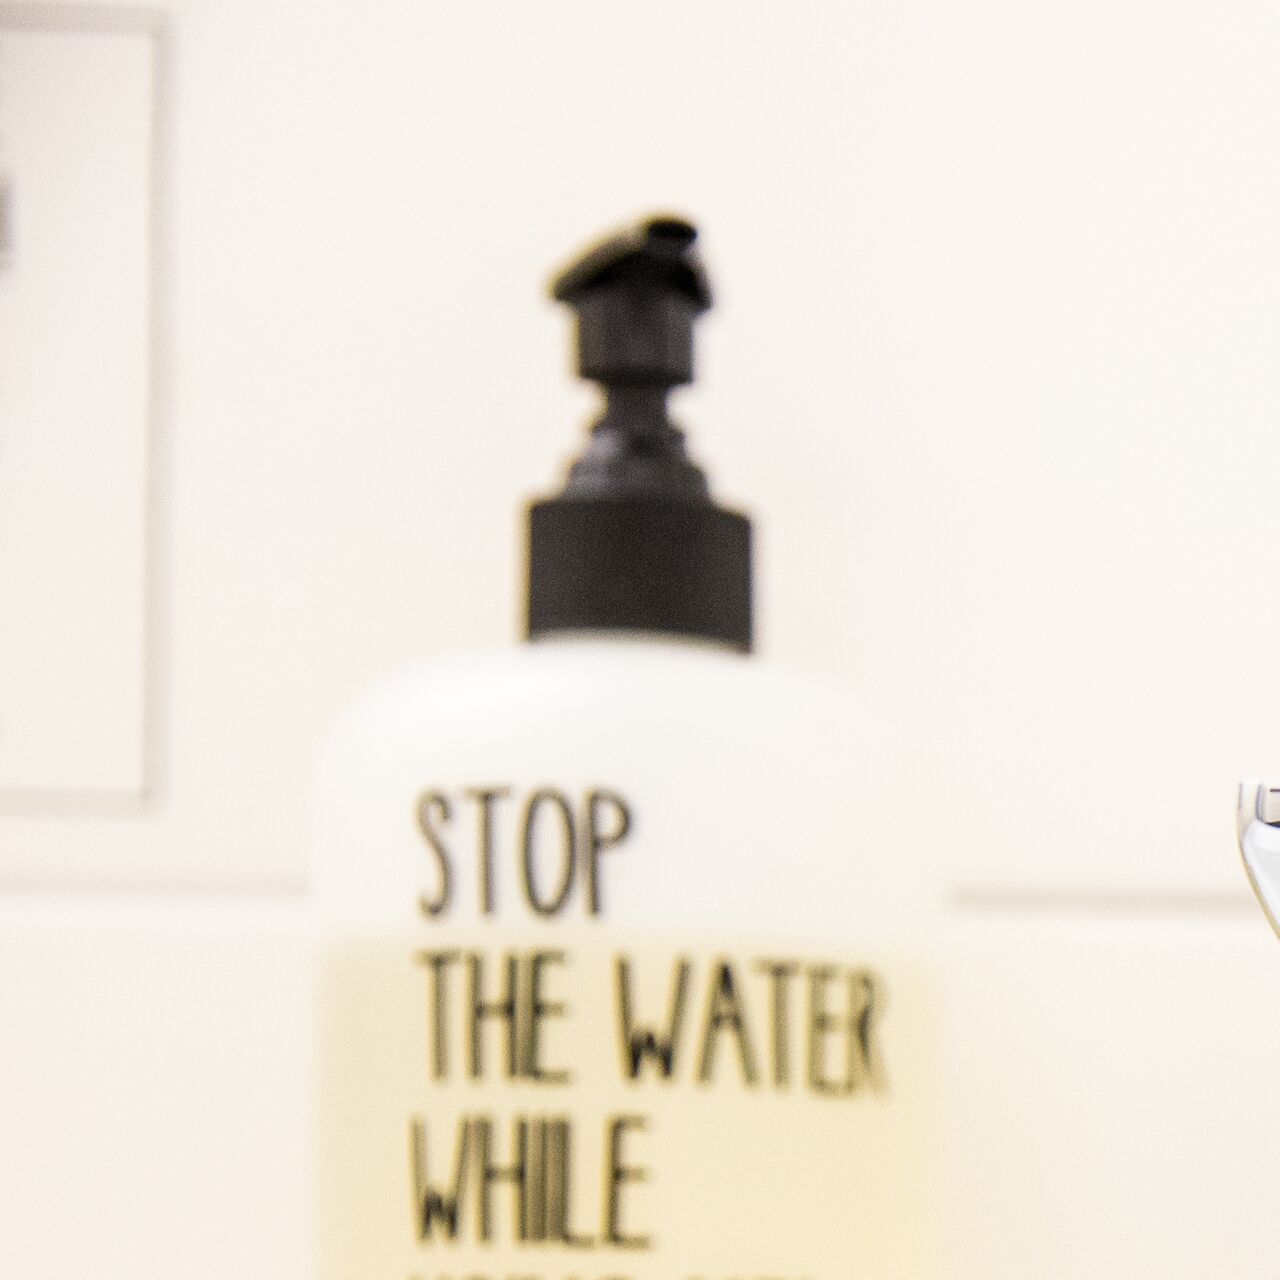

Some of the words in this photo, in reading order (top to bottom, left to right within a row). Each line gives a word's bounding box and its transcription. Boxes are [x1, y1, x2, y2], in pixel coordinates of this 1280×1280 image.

[414, 785, 634, 919] STOP
[413, 949, 571, 1083] THE
[612, 955, 889, 1098] WATER
[409, 1115, 652, 1248] WHILE
